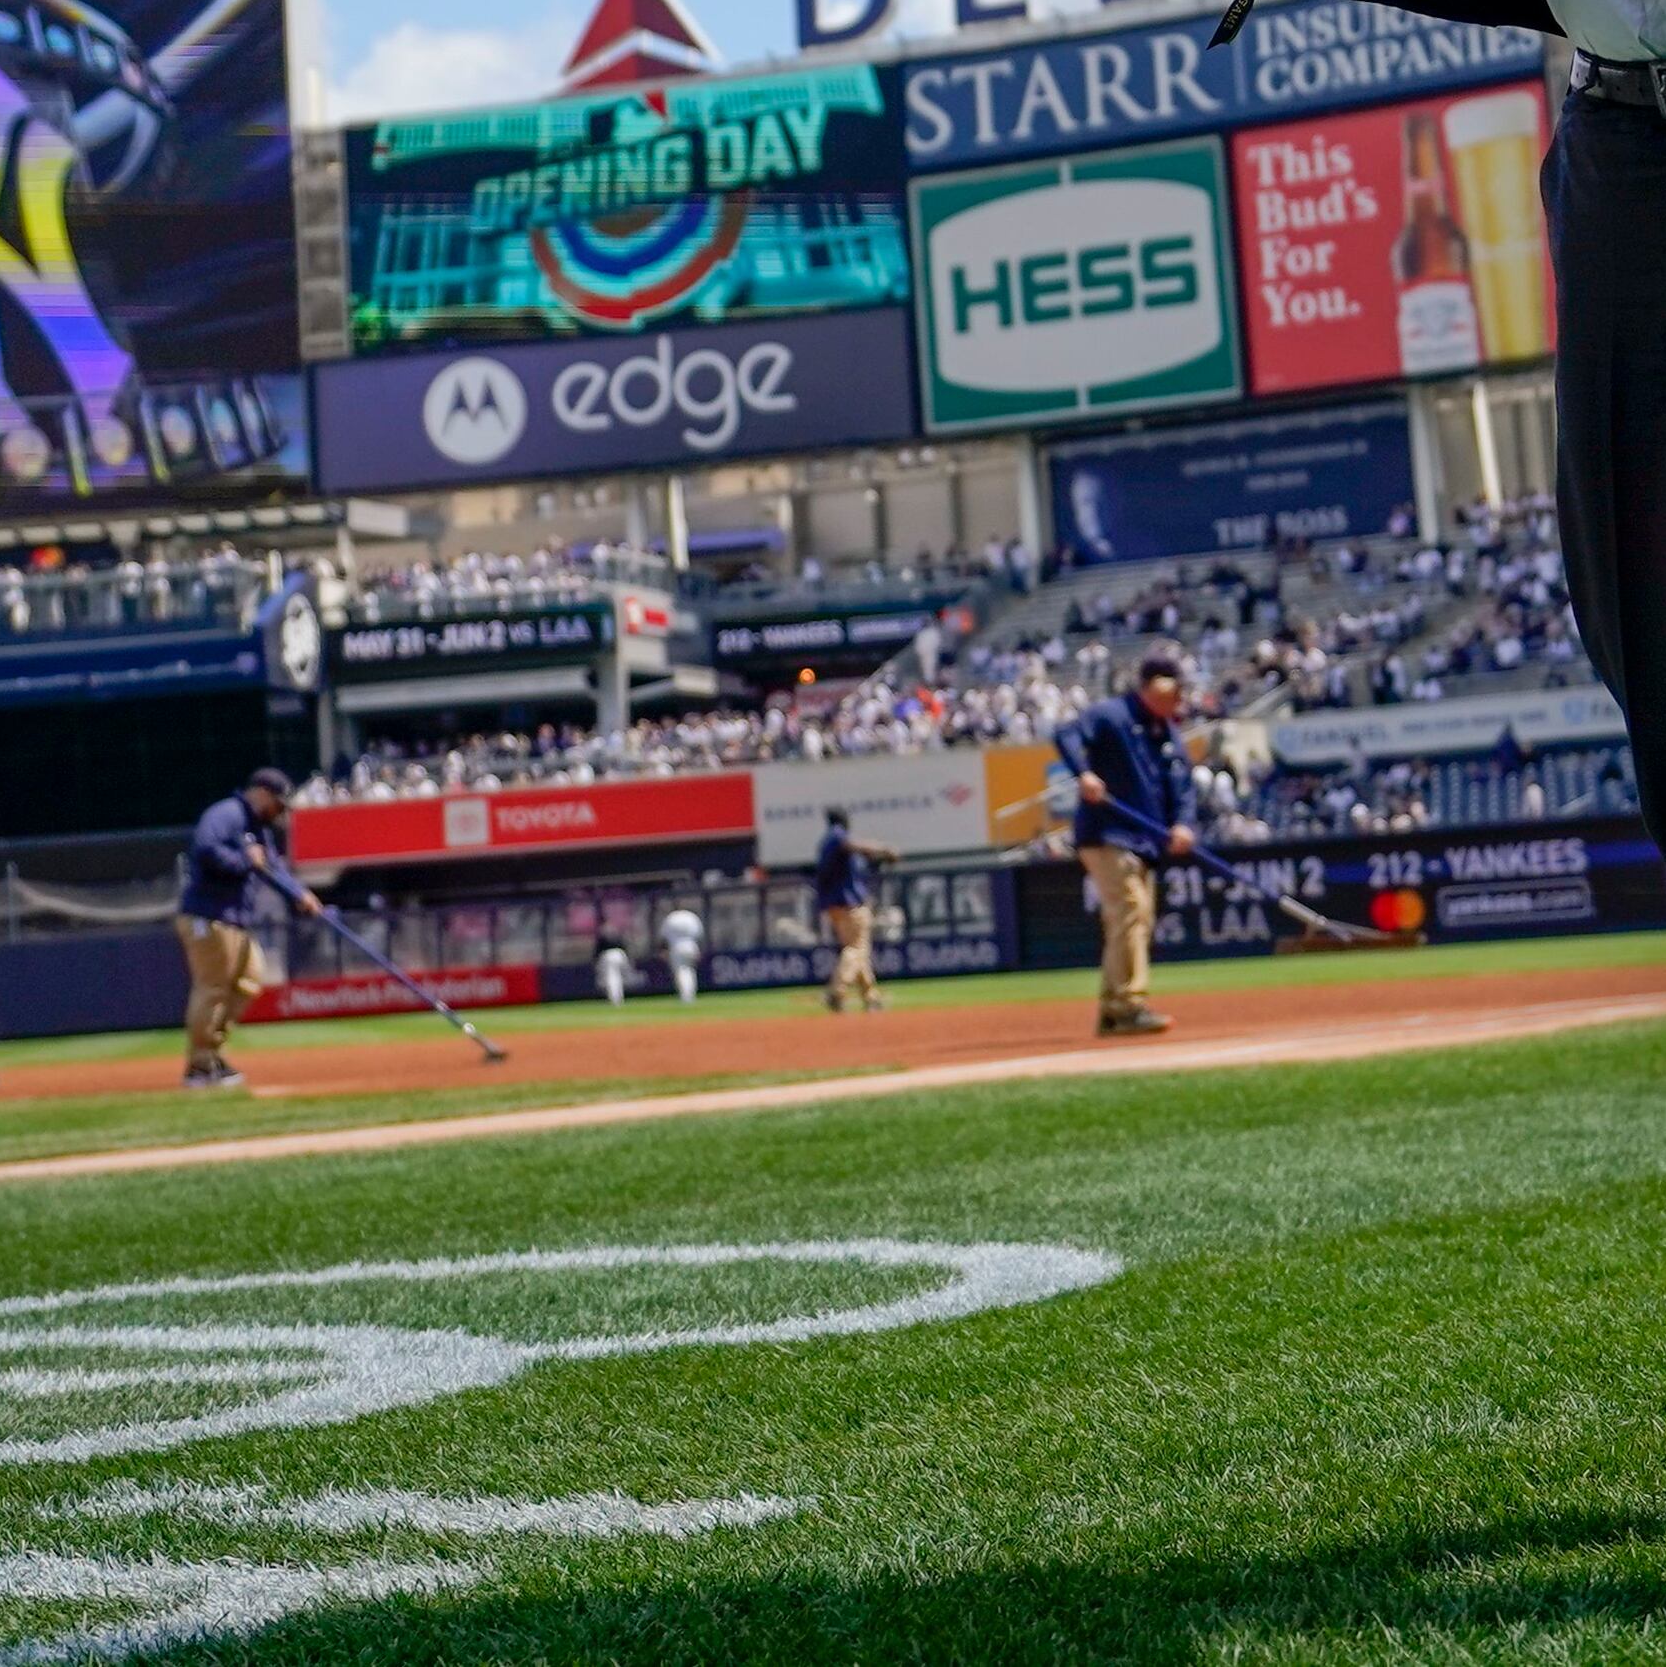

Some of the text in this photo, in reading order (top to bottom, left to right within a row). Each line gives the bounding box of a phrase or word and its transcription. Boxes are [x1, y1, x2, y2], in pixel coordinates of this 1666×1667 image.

[905, 33, 1222, 152] STARR
[1254, 32, 1542, 102] COMPANIES
[472, 101, 830, 234] OPENING DAY
[1247, 135, 1352, 188] This
[1256, 179, 1378, 234] Bud's
[950, 236, 1199, 334] HESS
[1259, 239, 1335, 281] For
[1261, 284, 1361, 328] You.
[552, 334, 797, 450] edge
[344, 631, 393, 661] MAY
[395, 626, 426, 656] 31
[438, 622, 488, 654] JUN
[489, 619, 507, 652] 2
[539, 614, 591, 643] LAA
[495, 800, 597, 830] TOYOTA
[1164, 865, 1204, 907] 31
[1301, 855, 1325, 897] 2
[1367, 851, 1423, 889] 212
[1443, 837, 1588, 881] YANKEES
[1199, 903, 1272, 942] LAA
